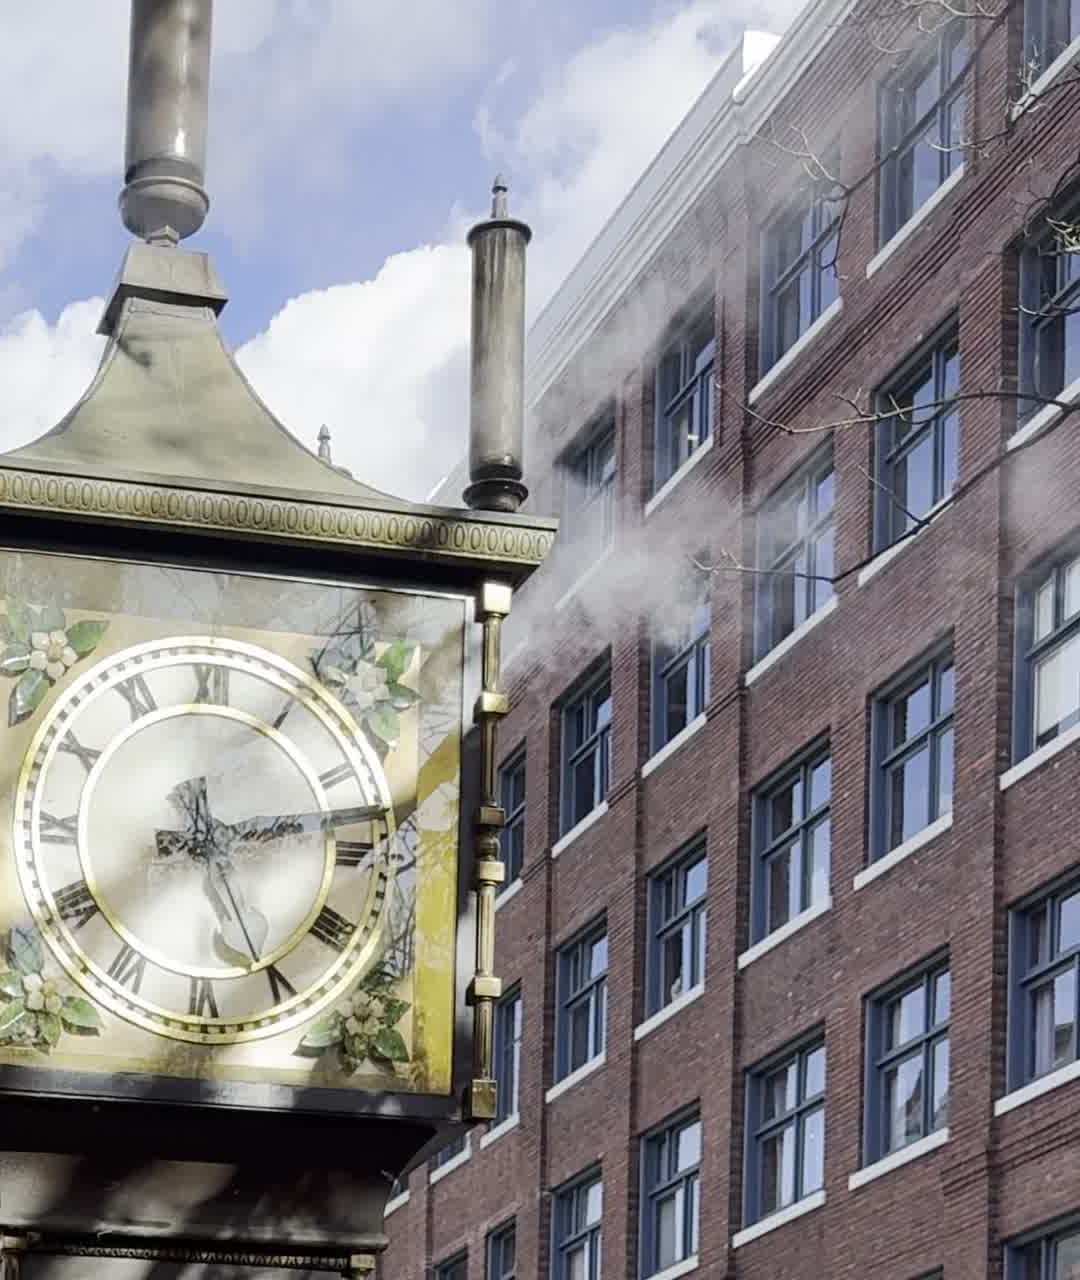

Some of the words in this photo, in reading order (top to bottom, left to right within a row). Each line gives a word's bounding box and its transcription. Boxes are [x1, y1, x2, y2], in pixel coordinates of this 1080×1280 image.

[114, 673, 159, 721] XI
[194, 663, 229, 705] XII
[272, 700, 295, 729] I
[58, 728, 103, 772] X
[319, 763, 356, 790] II
[39, 811, 79, 845] IX
[107, 943, 148, 995] VII
[265, 966, 299, 1004] V
[189, 976, 219, 1019] VI
